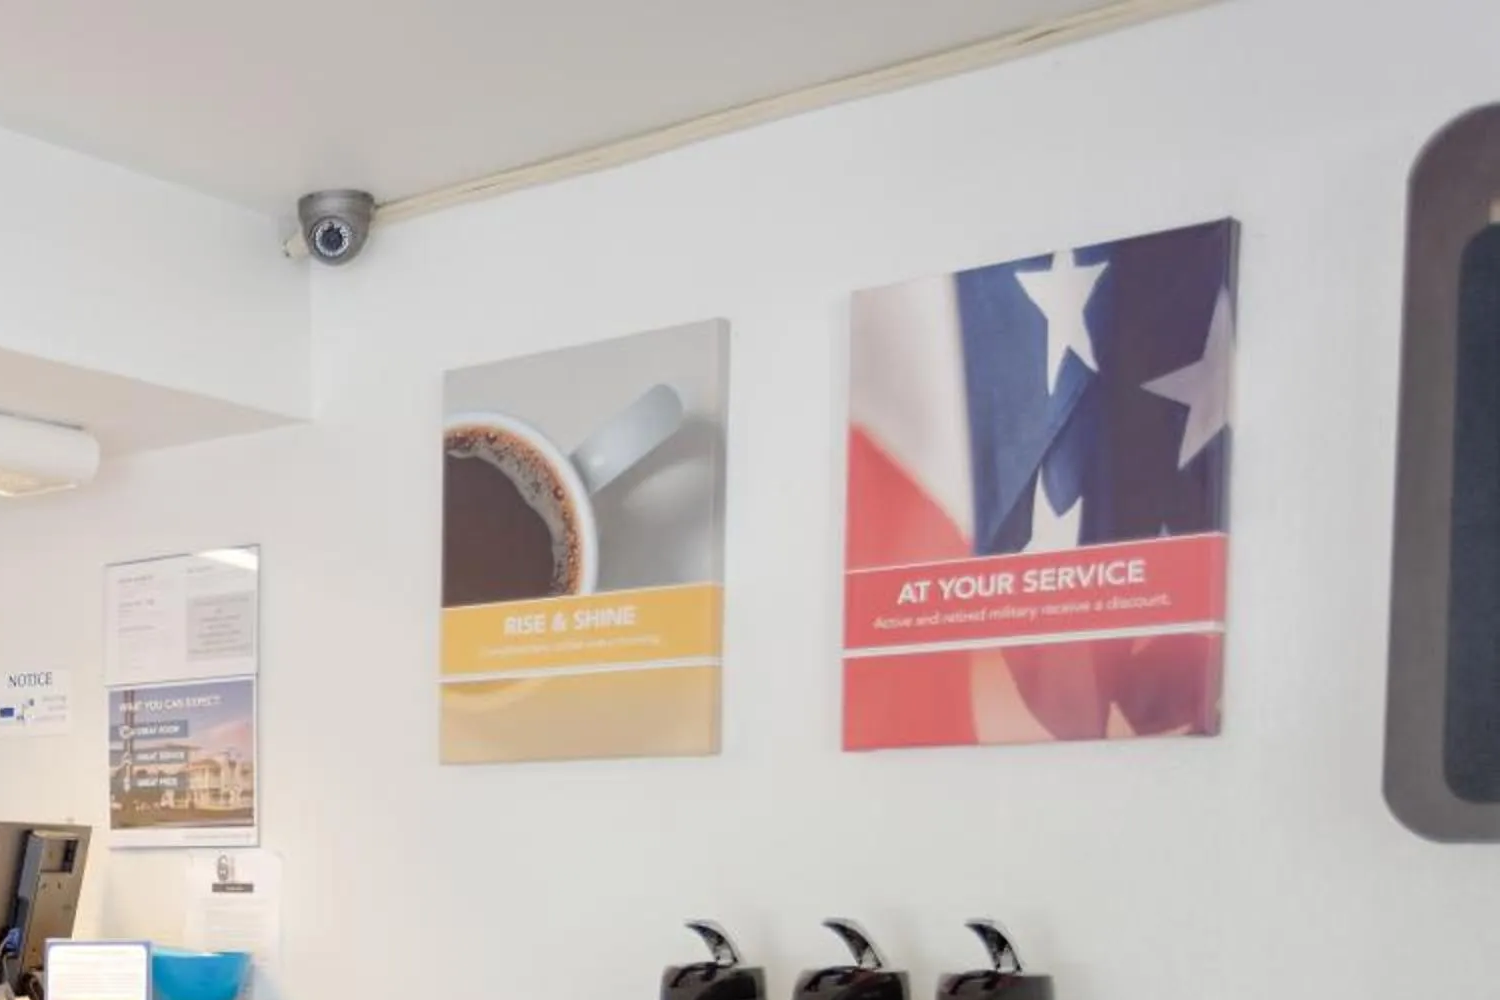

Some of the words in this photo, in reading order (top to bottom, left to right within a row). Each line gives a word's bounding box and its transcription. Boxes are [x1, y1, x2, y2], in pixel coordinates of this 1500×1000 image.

[897, 581, 931, 605] AT
[940, 572, 1015, 601] YOUR
[1022, 558, 1146, 593] SERVICE
[503, 613, 546, 636] RISE
[573, 605, 637, 630] SHINE
[916, 611, 940, 627] and
[7, 671, 52, 688] NOTICE
